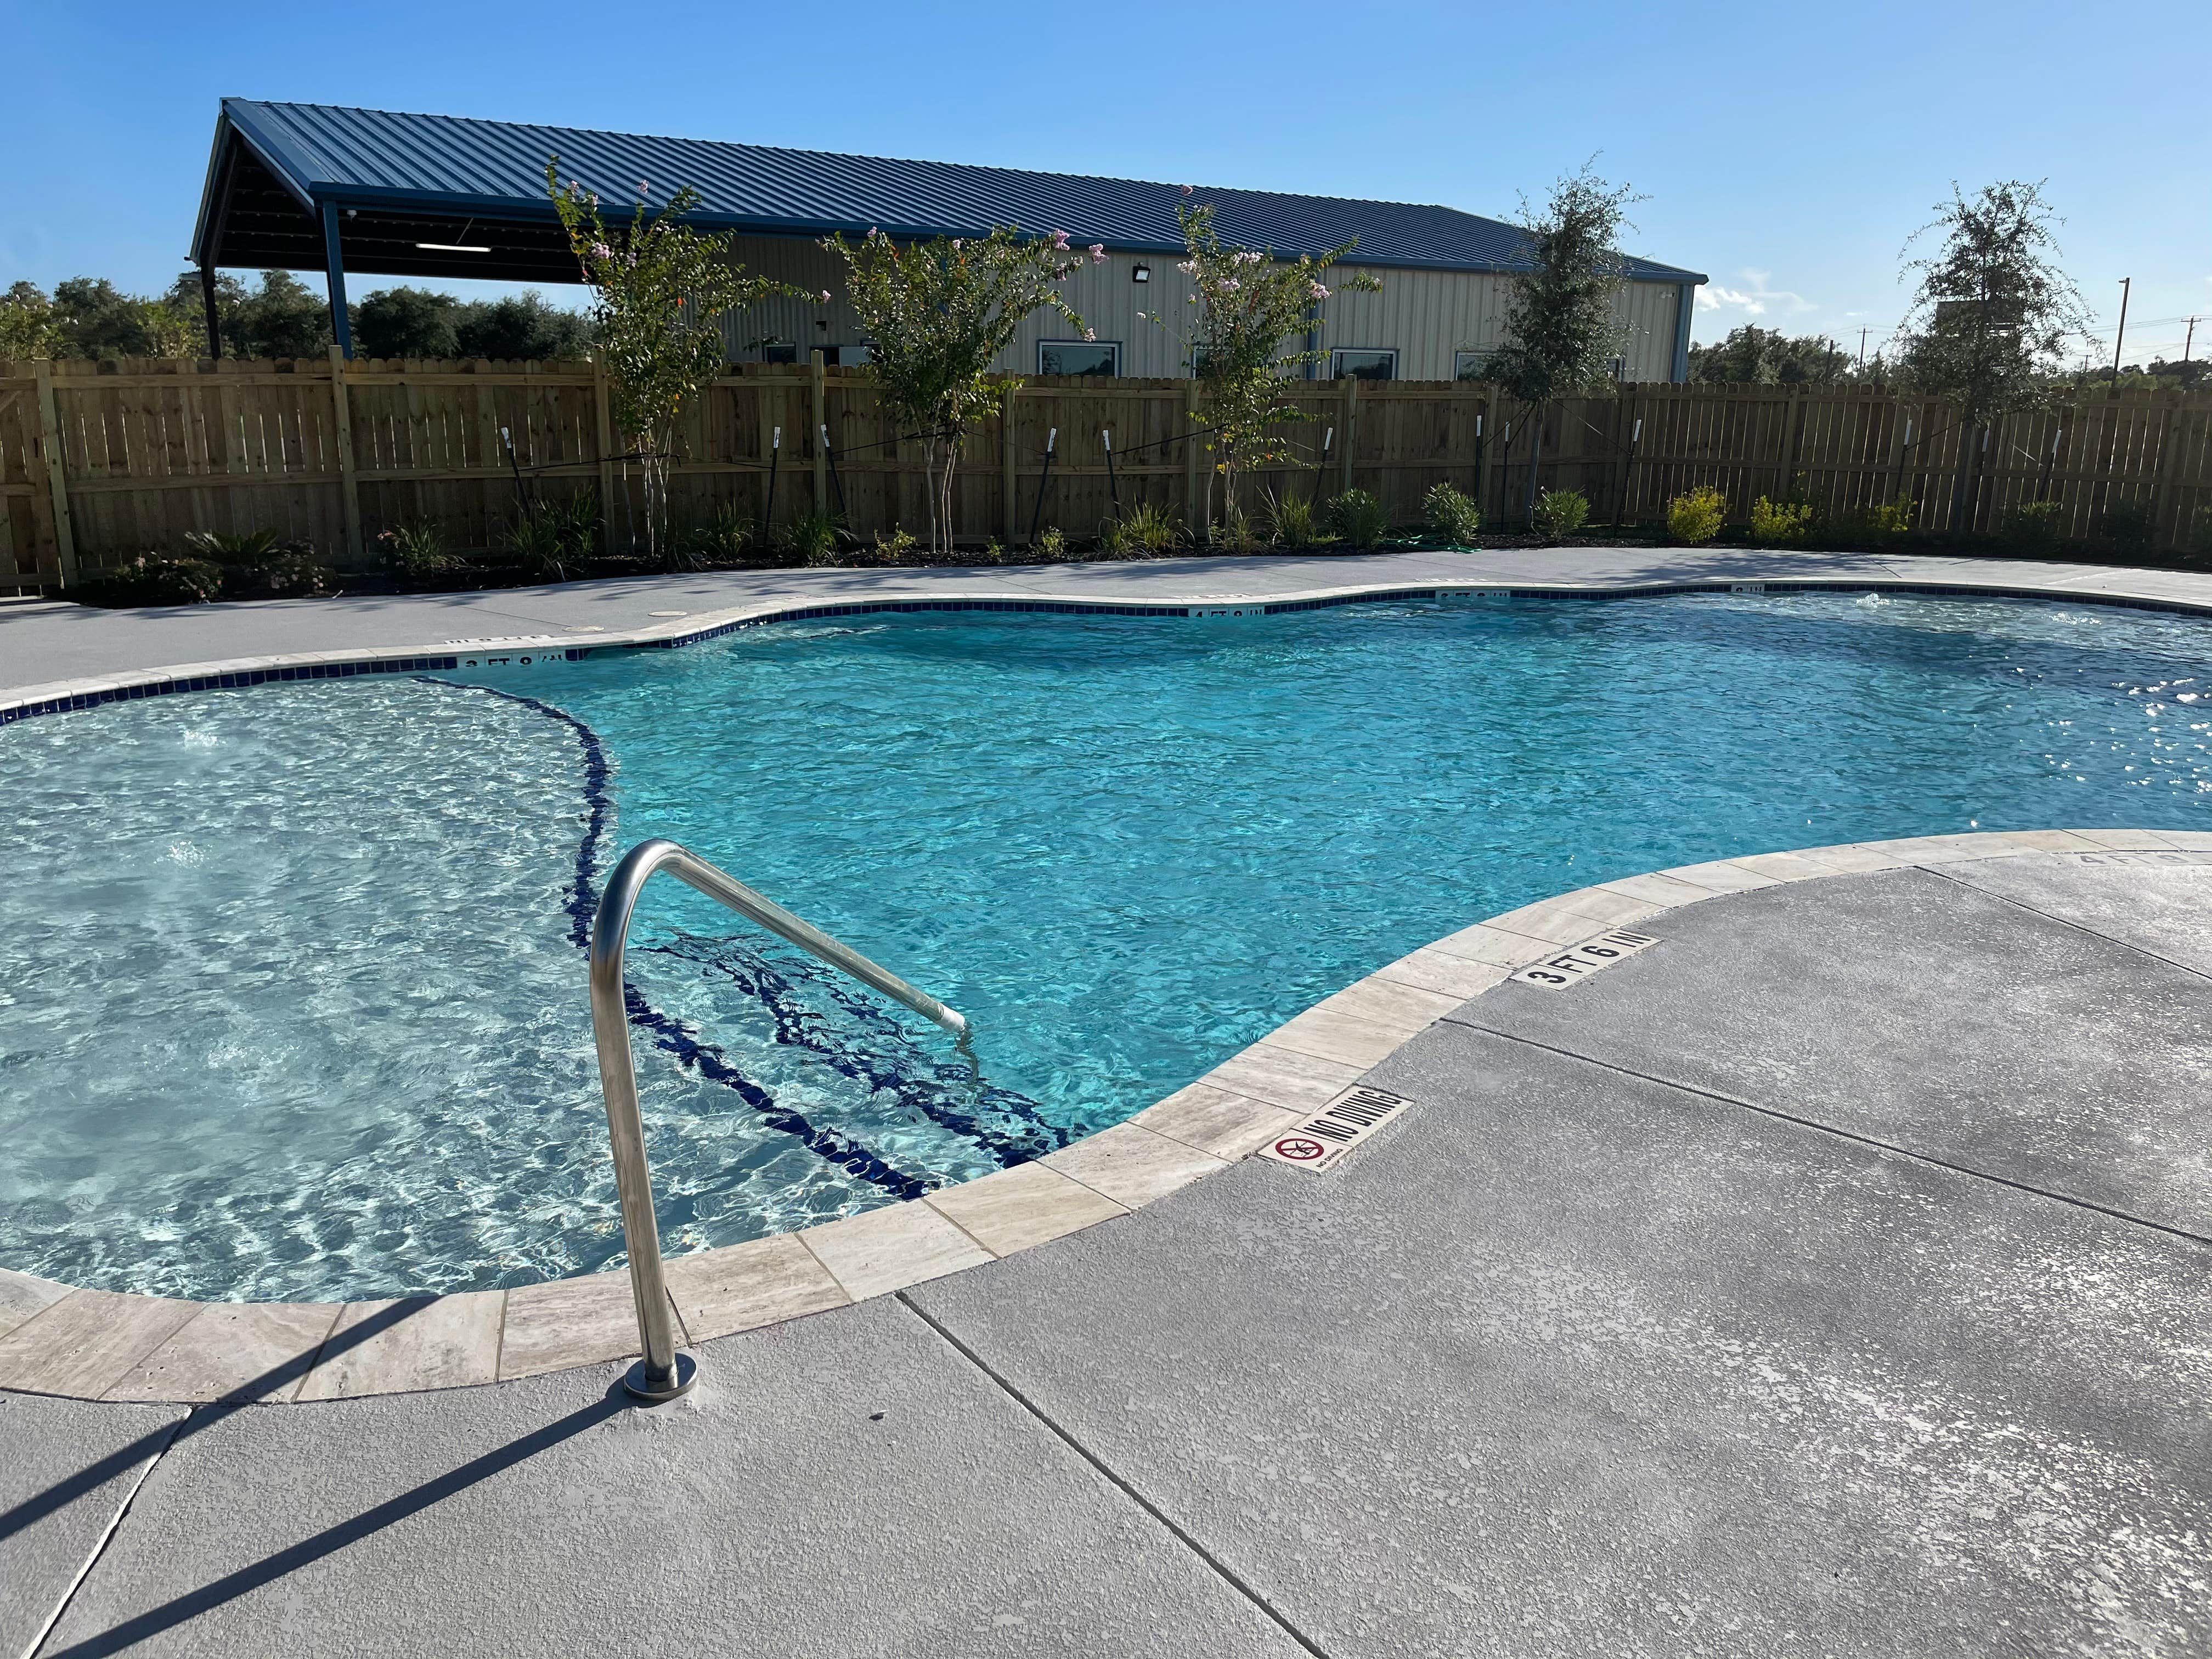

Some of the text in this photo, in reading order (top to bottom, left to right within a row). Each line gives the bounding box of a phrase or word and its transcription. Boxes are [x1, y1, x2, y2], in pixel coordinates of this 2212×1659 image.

[2080, 855, 2107, 865] 4
[2107, 855, 2153, 865] FT
[1527, 932, 1652, 984] 3 FT 6 IN
[1303, 1090, 1403, 1142] NO DIVING
[1324, 1148, 1344, 1161] DIVING
